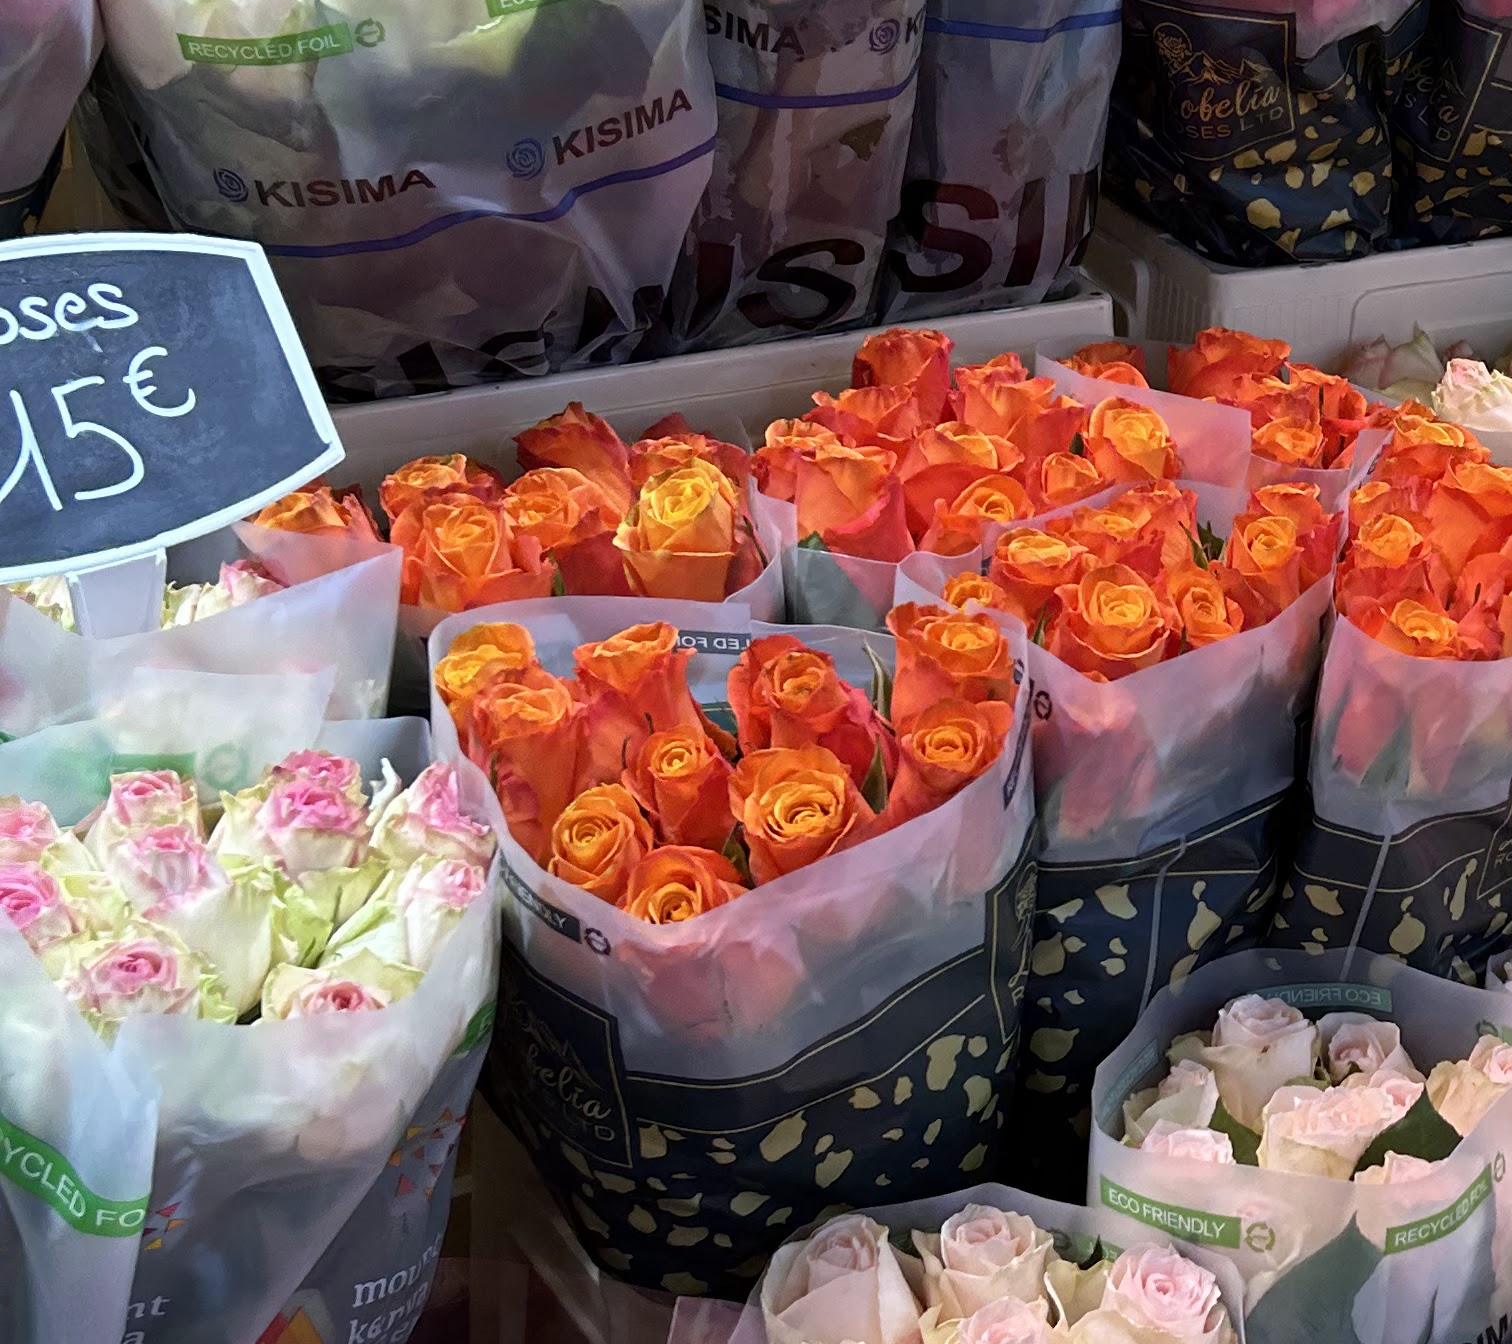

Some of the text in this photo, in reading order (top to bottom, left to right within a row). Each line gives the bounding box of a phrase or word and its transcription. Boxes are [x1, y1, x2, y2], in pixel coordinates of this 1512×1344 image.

[188, 32, 341, 62] RECYCLED FOIL
[551, 87, 692, 166] KISIMA
[1180, 82, 1280, 122] obelia
[254, 168, 437, 208] KISIMA
[1, 1135, 88, 1218] YCLED
[1108, 1187, 1227, 1240] ECO FRIENDLY
[1394, 1197, 1470, 1248] RECYCLED
